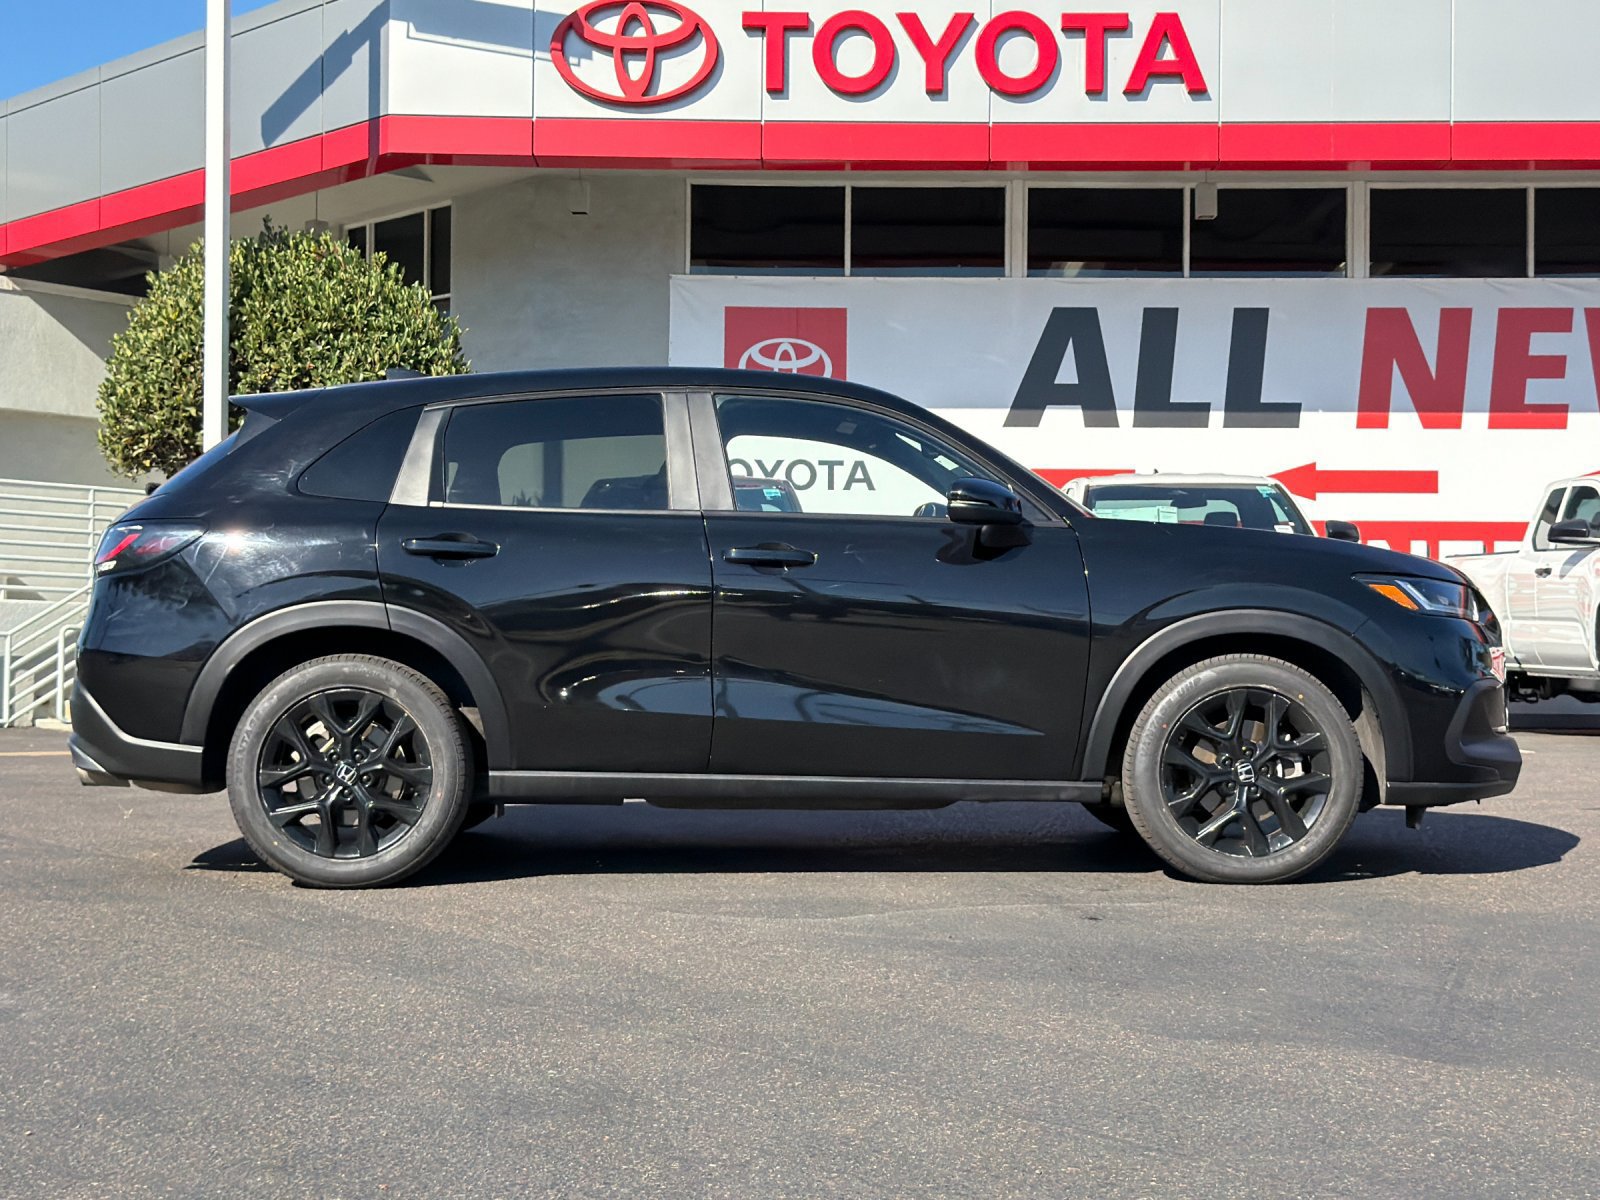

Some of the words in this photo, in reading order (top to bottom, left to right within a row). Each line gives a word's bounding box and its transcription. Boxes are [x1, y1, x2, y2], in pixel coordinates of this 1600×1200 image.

[742, 10, 1208, 95] TOYOTA
[1003, 307, 1302, 428] ALL
[728, 458, 876, 491] OYOTA
